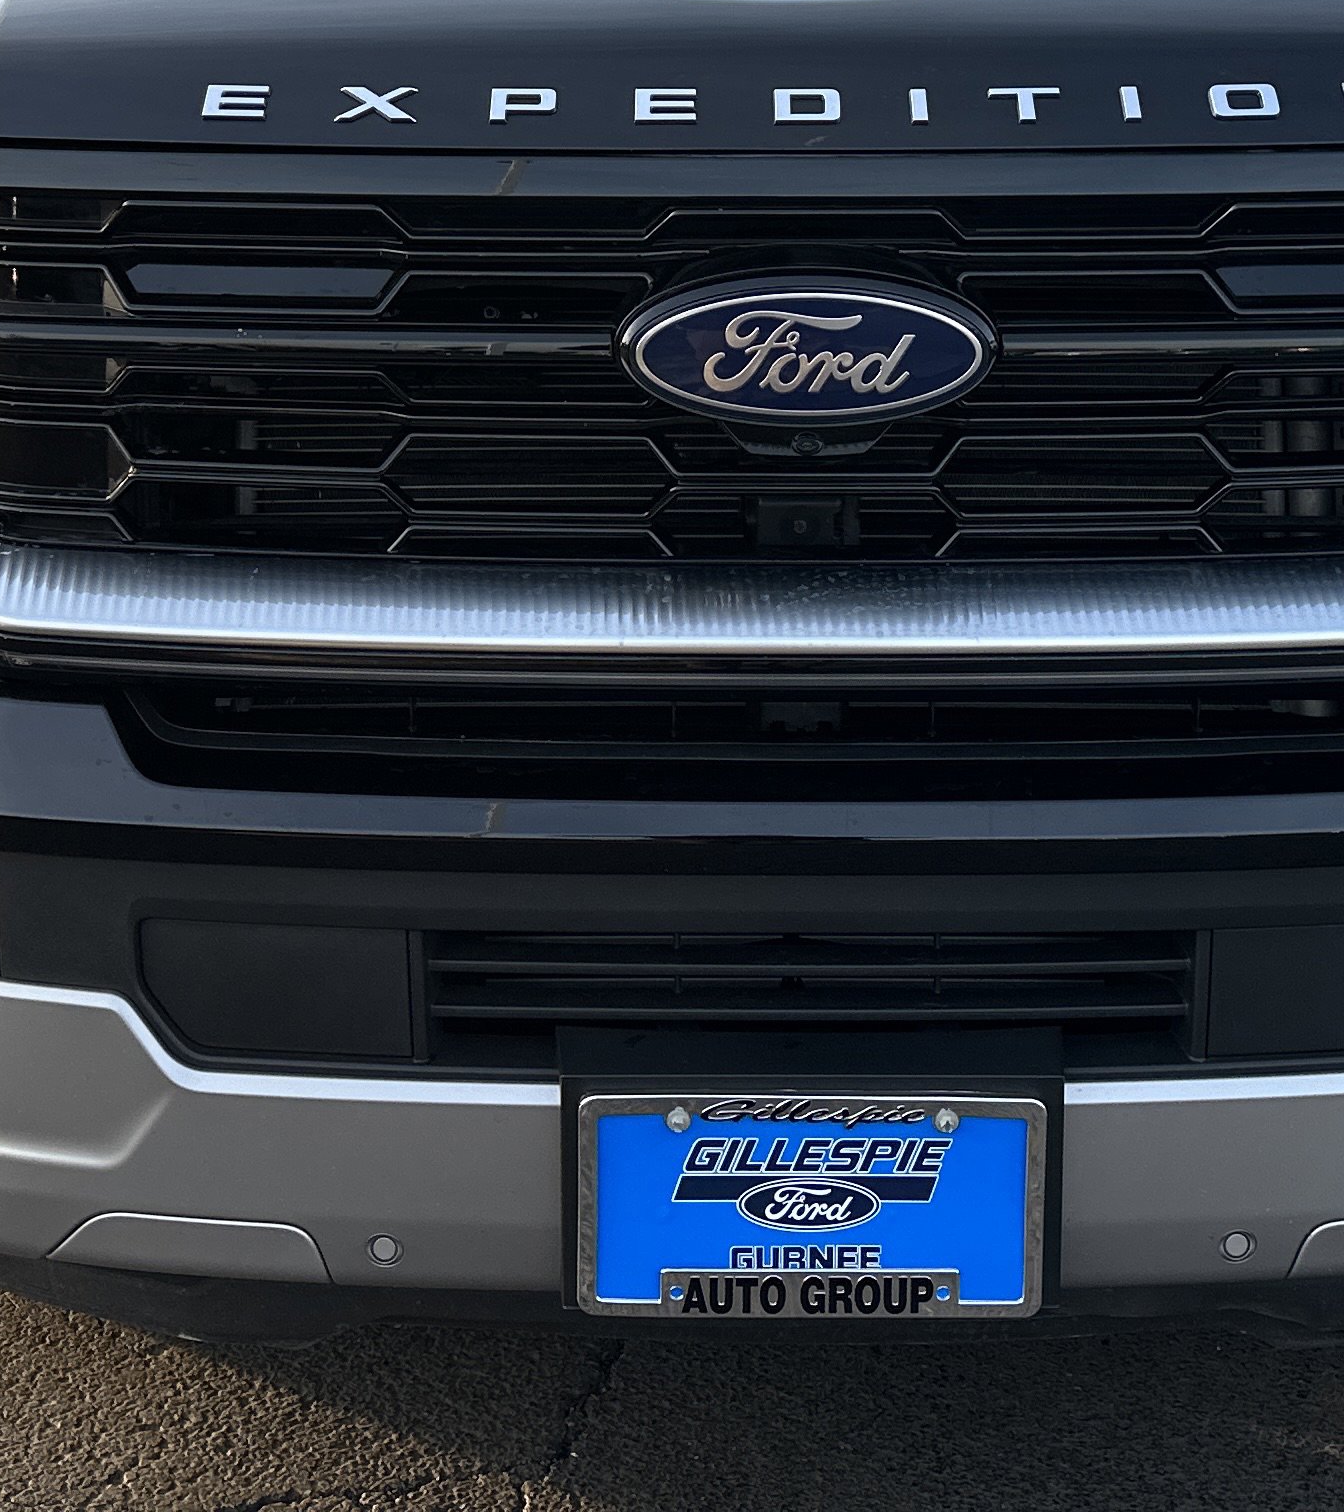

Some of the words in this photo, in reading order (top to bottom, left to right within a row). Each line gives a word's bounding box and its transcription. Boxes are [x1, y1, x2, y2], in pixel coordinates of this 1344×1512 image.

[704, 310, 916, 393] Ford
[701, 1099, 925, 1129] Gillespie
[683, 1137, 953, 1173] GILLESPIE
[765, 1186, 852, 1222] Ford
[729, 1245, 882, 1269] GURNEE
[682, 1275, 787, 1314] AUTO
[800, 1275, 934, 1314] GROUP
